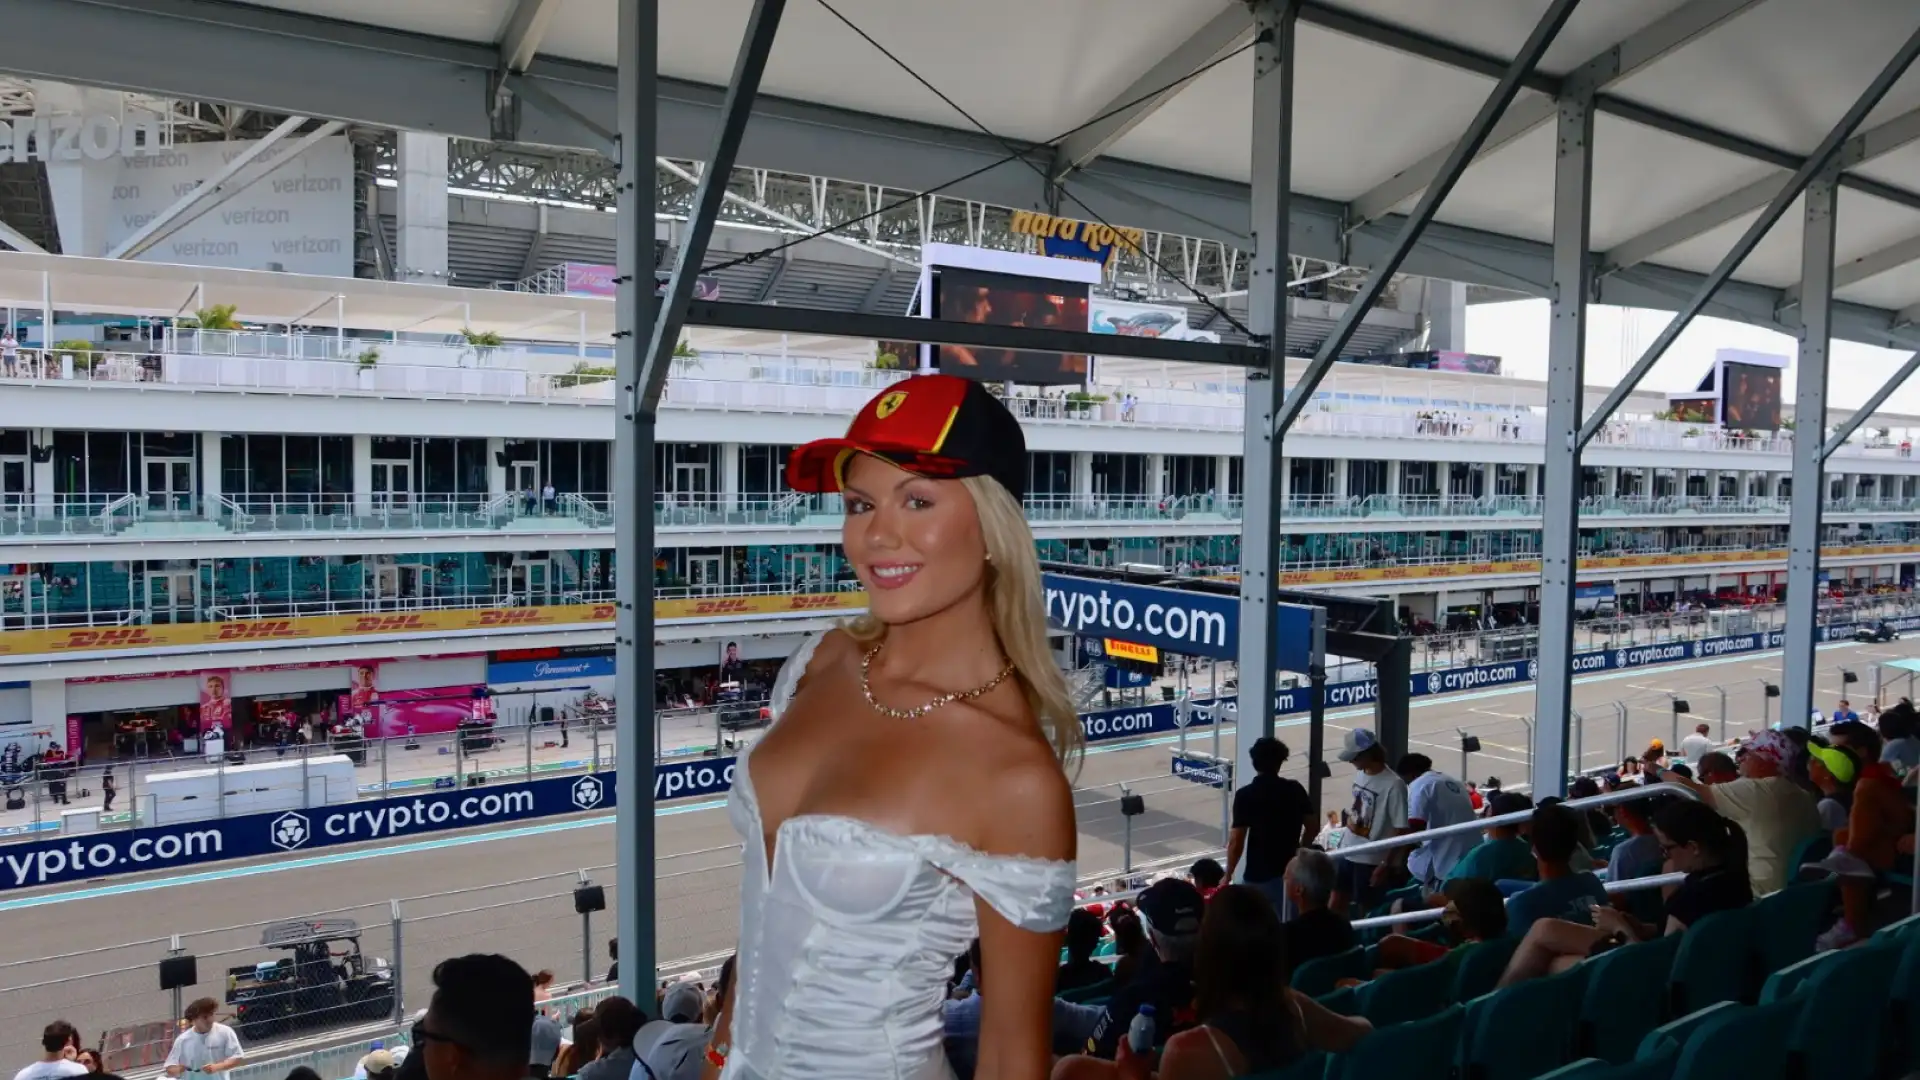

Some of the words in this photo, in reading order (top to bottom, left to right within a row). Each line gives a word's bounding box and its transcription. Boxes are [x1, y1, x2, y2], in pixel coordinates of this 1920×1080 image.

[273, 173, 342, 194] verizon
[222, 206, 290, 226] verizon
[172, 238, 239, 257] verizon
[272, 235, 342, 255] verizon
[696, 599, 749, 614] DHL
[790, 595, 839, 609] DHL
[356, 615, 424, 631] DHL
[479, 609, 541, 625] DHL
[1041, 587, 1227, 647] rypto.com
[68, 629, 152, 648] DHL
[219, 621, 294, 640] DHL
[1629, 645, 1684, 663] crypto.com
[1704, 636, 1754, 655] crypto.com
[1573, 654, 1606, 671] o.com
[1444, 664, 1517, 689] crypto.com
[1331, 681, 1378, 704] crypto
[1080, 711, 1153, 736] to.com
[324, 790, 534, 837] crypto.com
[0, 829, 222, 886] ypto.com
